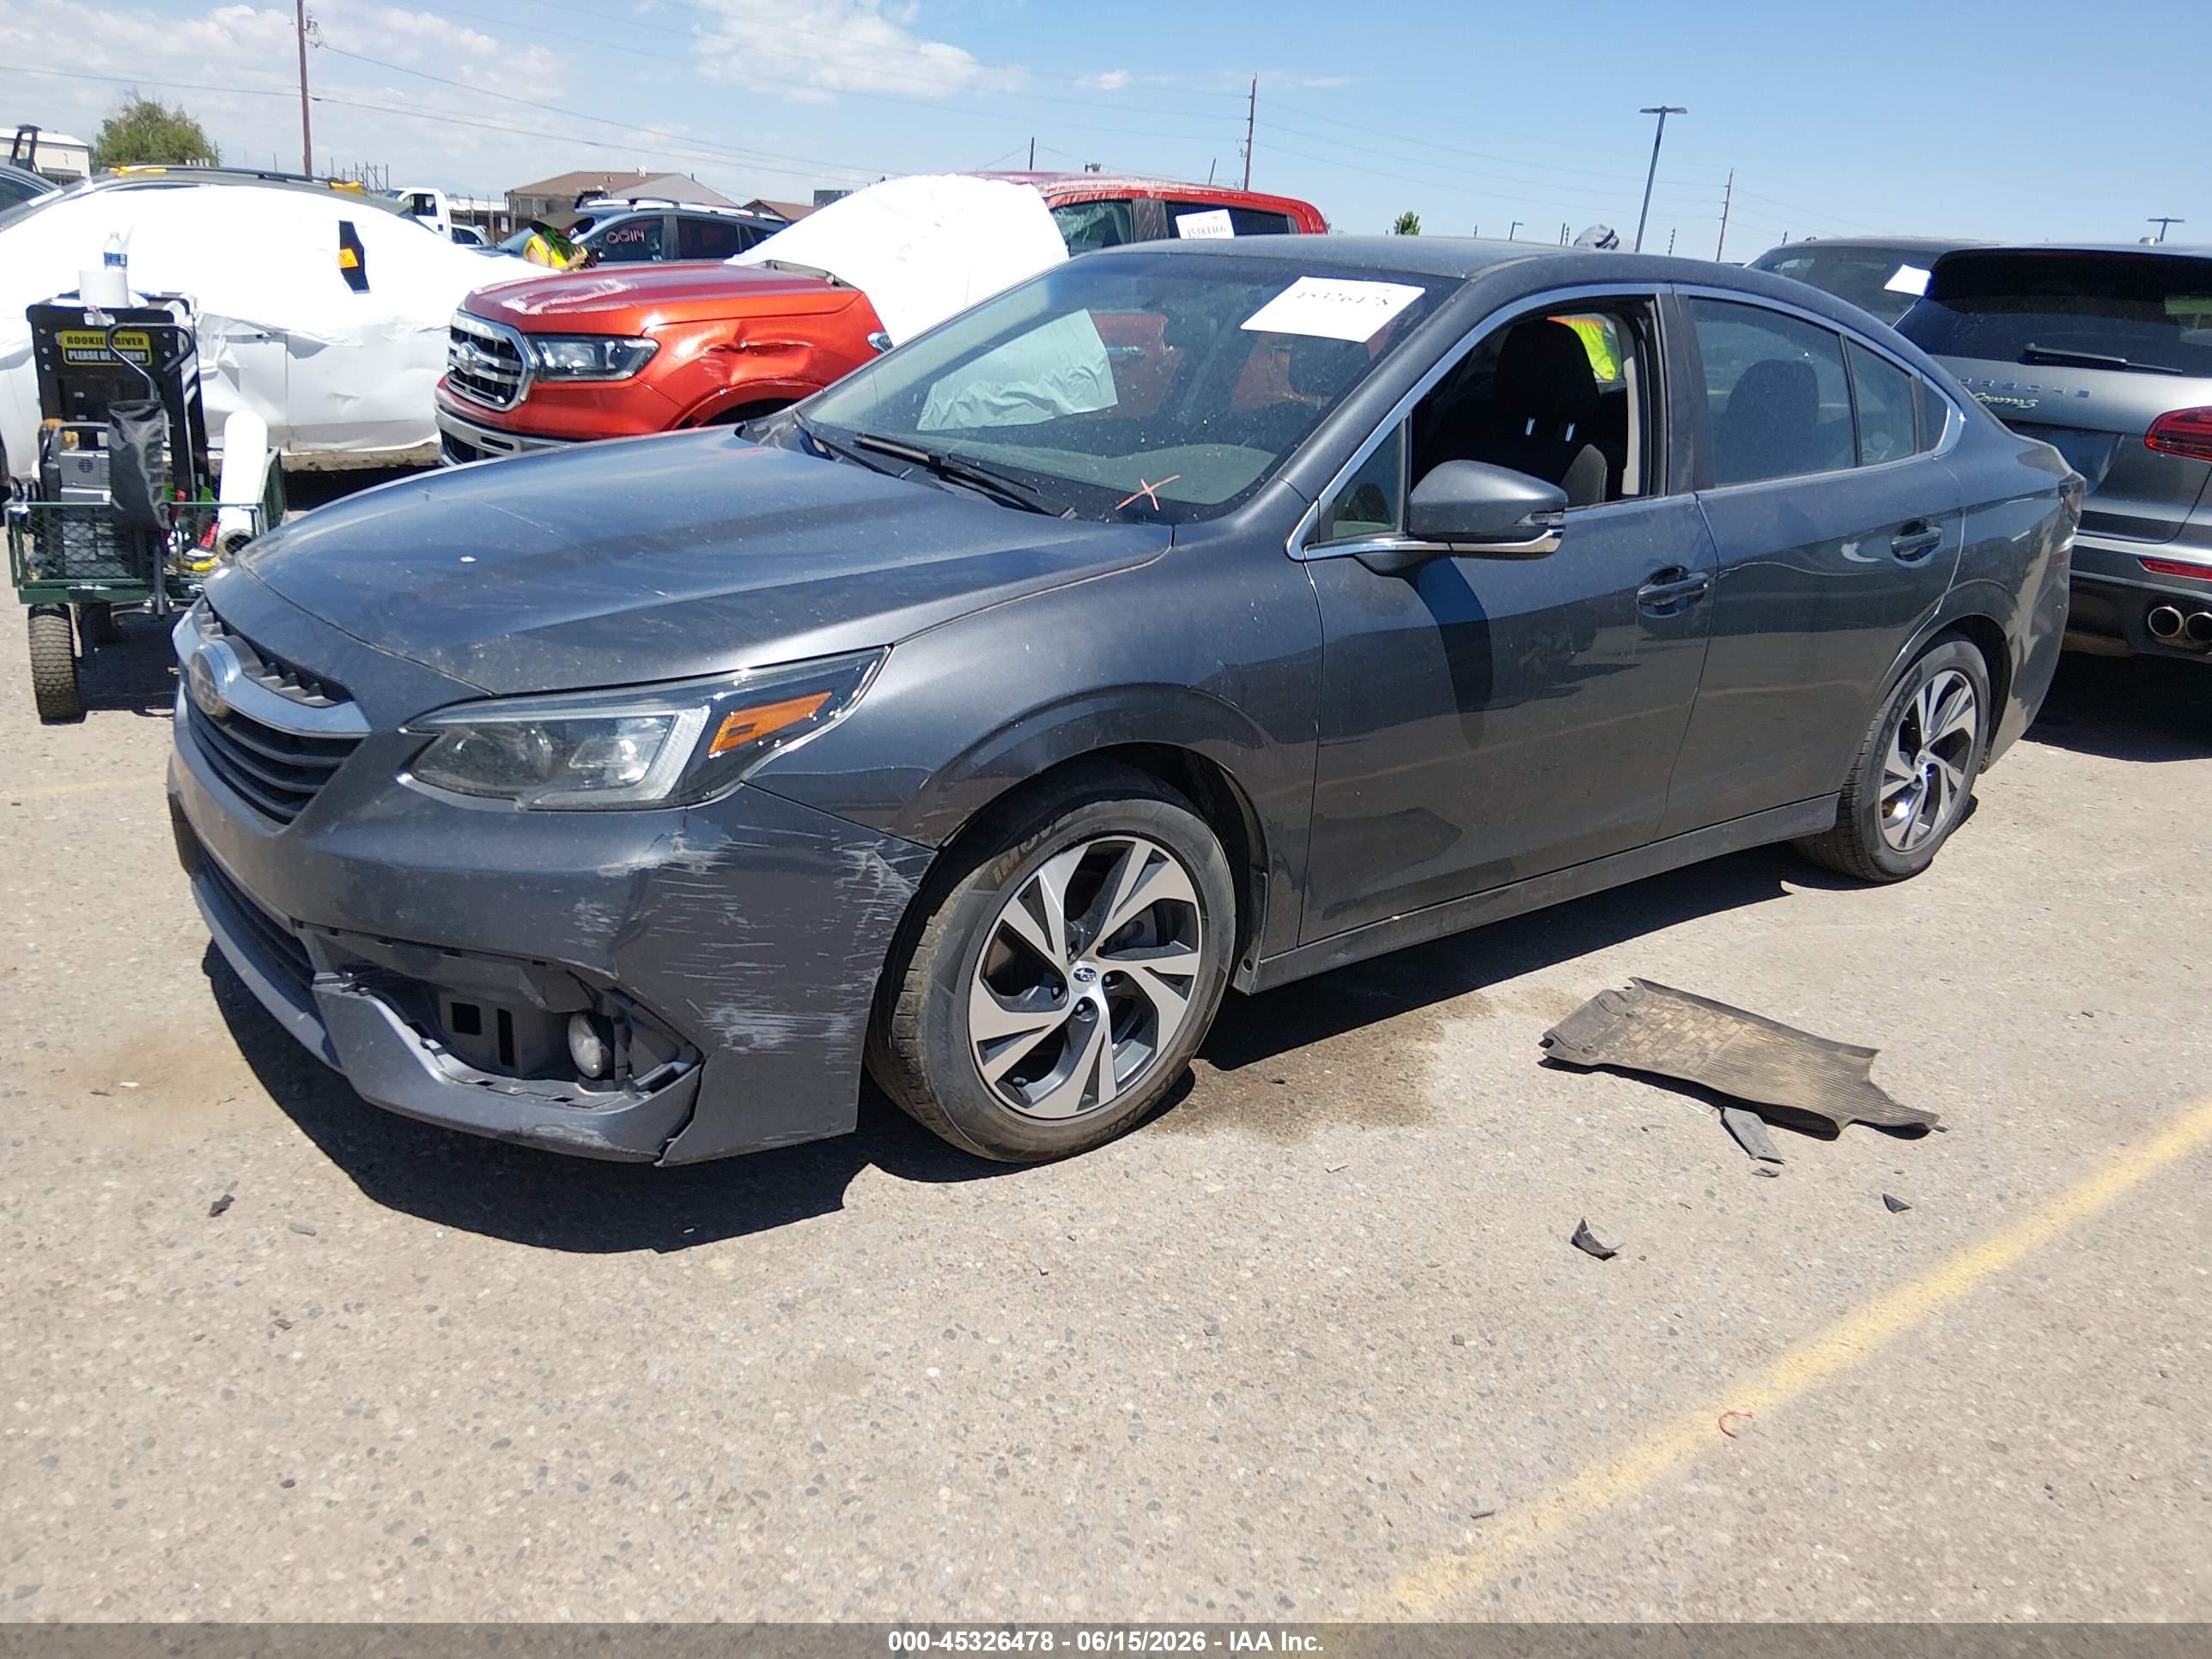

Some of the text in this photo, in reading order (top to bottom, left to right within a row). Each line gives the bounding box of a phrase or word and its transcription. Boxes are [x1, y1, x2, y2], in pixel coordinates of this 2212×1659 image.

[606, 228, 646, 244] 00114
[66, 336, 144, 345] ROOKIE RIVER
[68, 350, 99, 361] PLEASE
